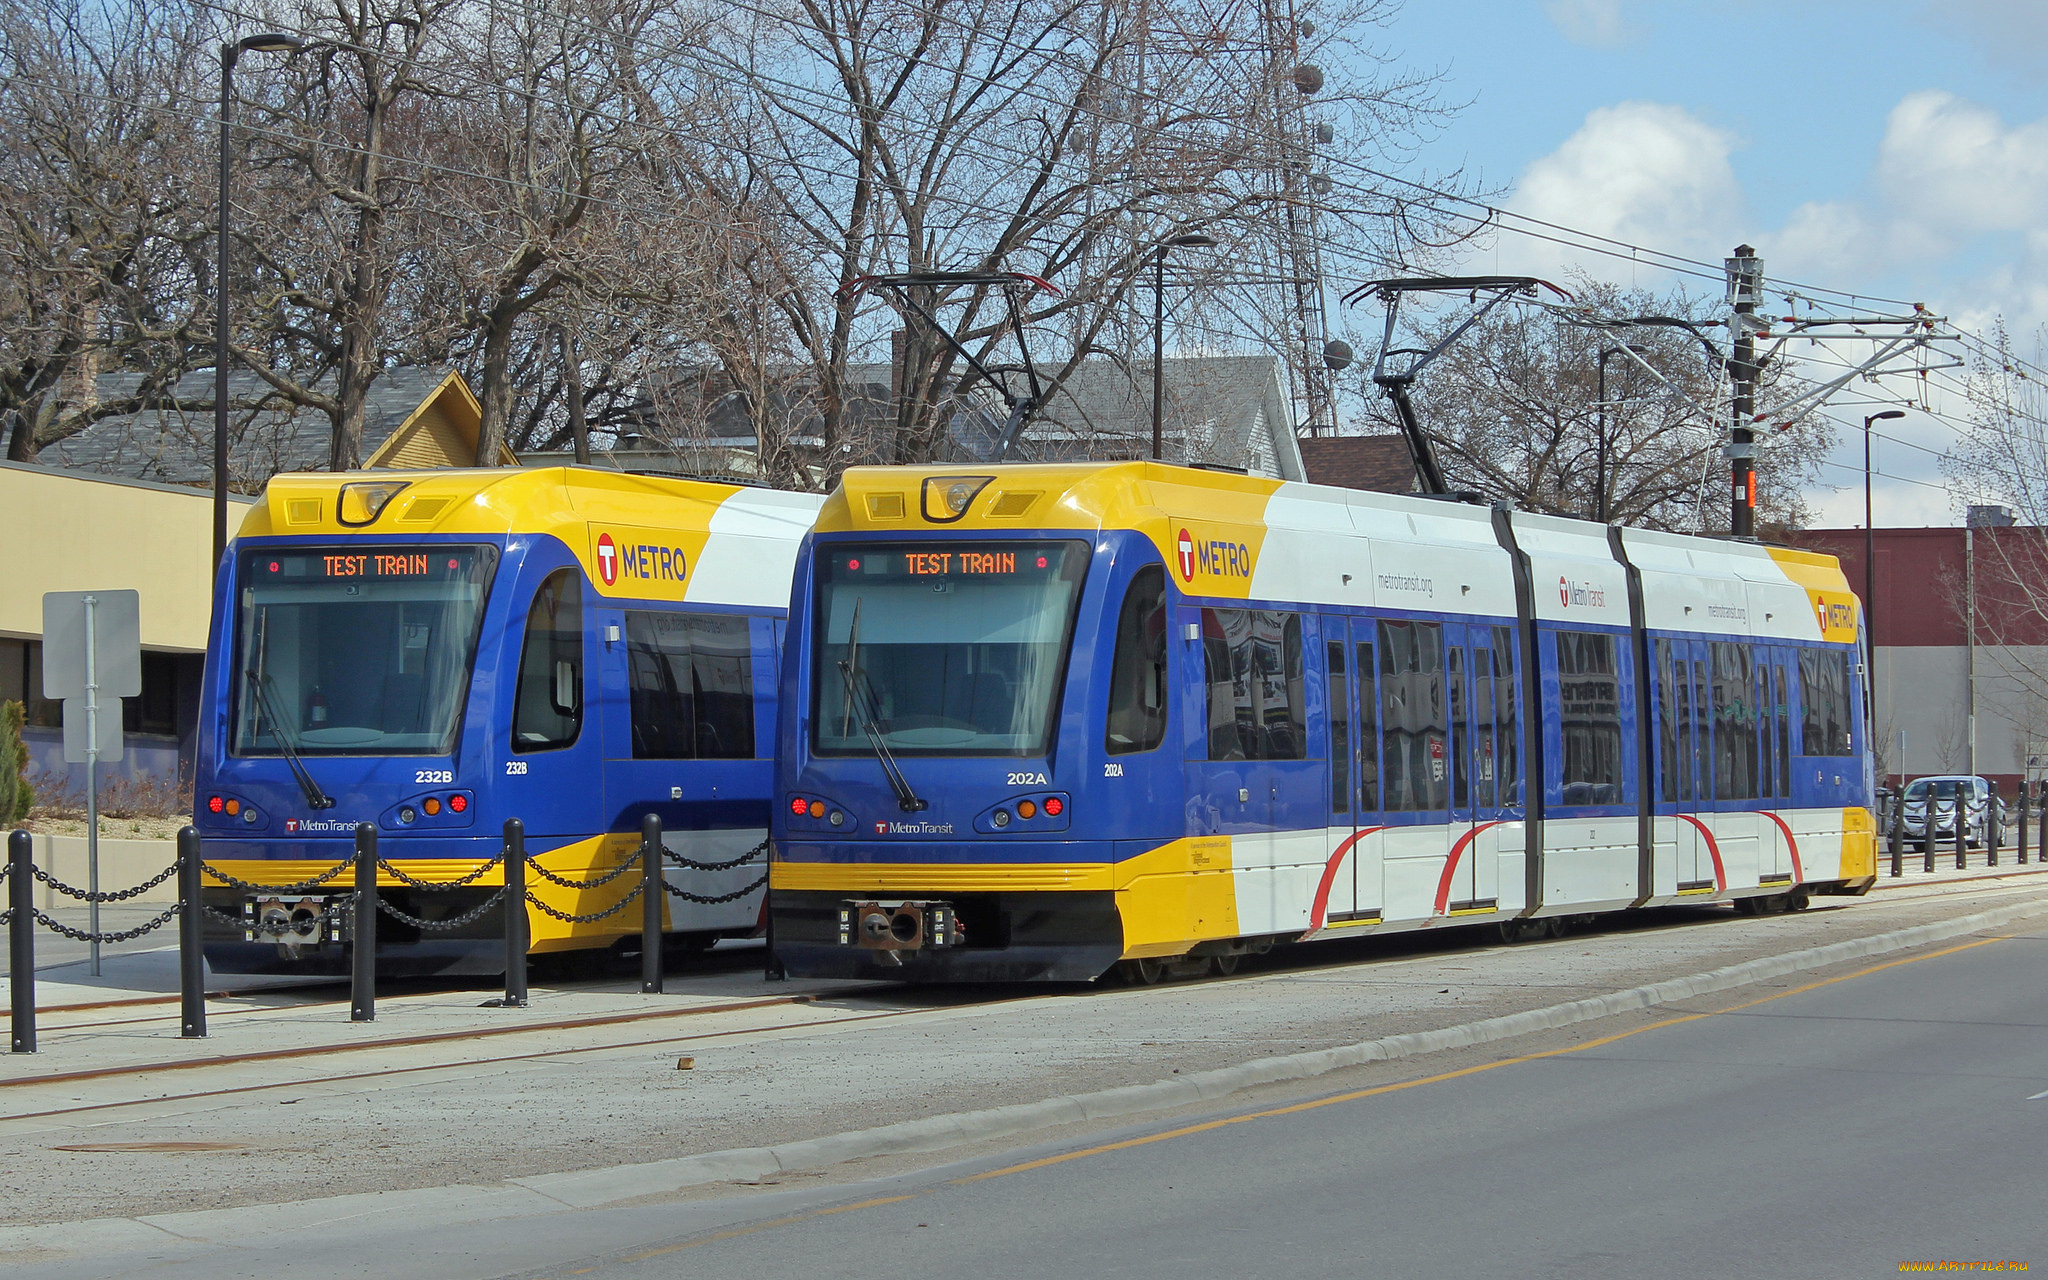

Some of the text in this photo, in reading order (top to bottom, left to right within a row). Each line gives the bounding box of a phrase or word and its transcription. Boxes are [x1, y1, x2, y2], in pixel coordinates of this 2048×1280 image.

[323, 554, 428, 576] TEST TRAIN
[621, 543, 686, 581] METRO
[905, 552, 1015, 574] TEST TRAIN
[1197, 539, 1250, 577] METRO
[1378, 571, 1433, 599] metrotransit.org
[1826, 603, 1853, 629] METRO
[415, 770, 453, 783] 232B
[506, 761, 528, 775] 232B
[1007, 772, 1048, 785] 202A
[1104, 763, 1124, 777] 202A
